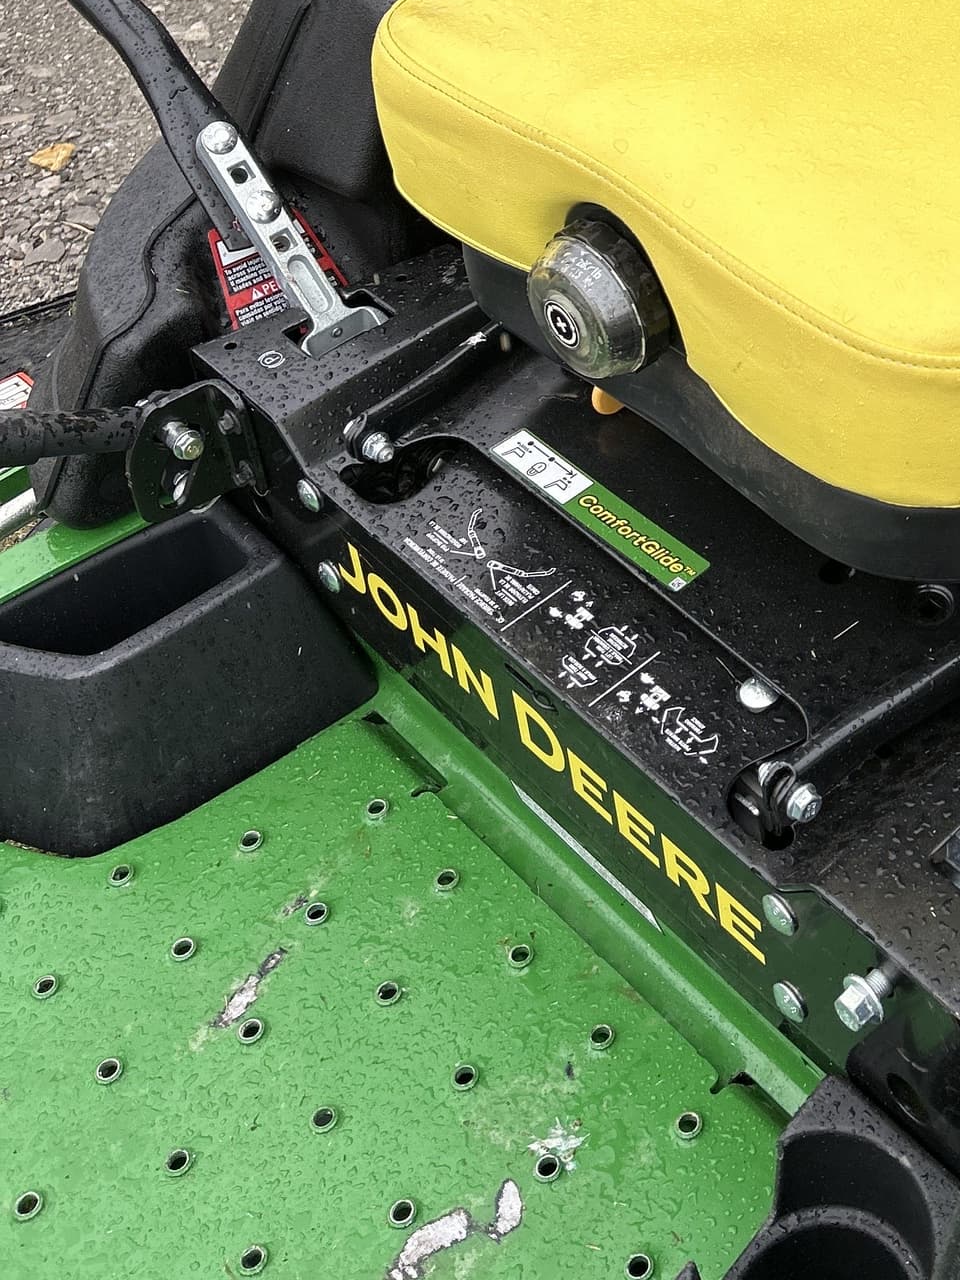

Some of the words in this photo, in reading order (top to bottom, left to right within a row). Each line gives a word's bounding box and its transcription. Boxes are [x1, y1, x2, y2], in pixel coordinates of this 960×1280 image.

[261, 279, 278, 295] PE
[338, 542, 500, 722] JOHN
[511, 689, 768, 965] DEERE
